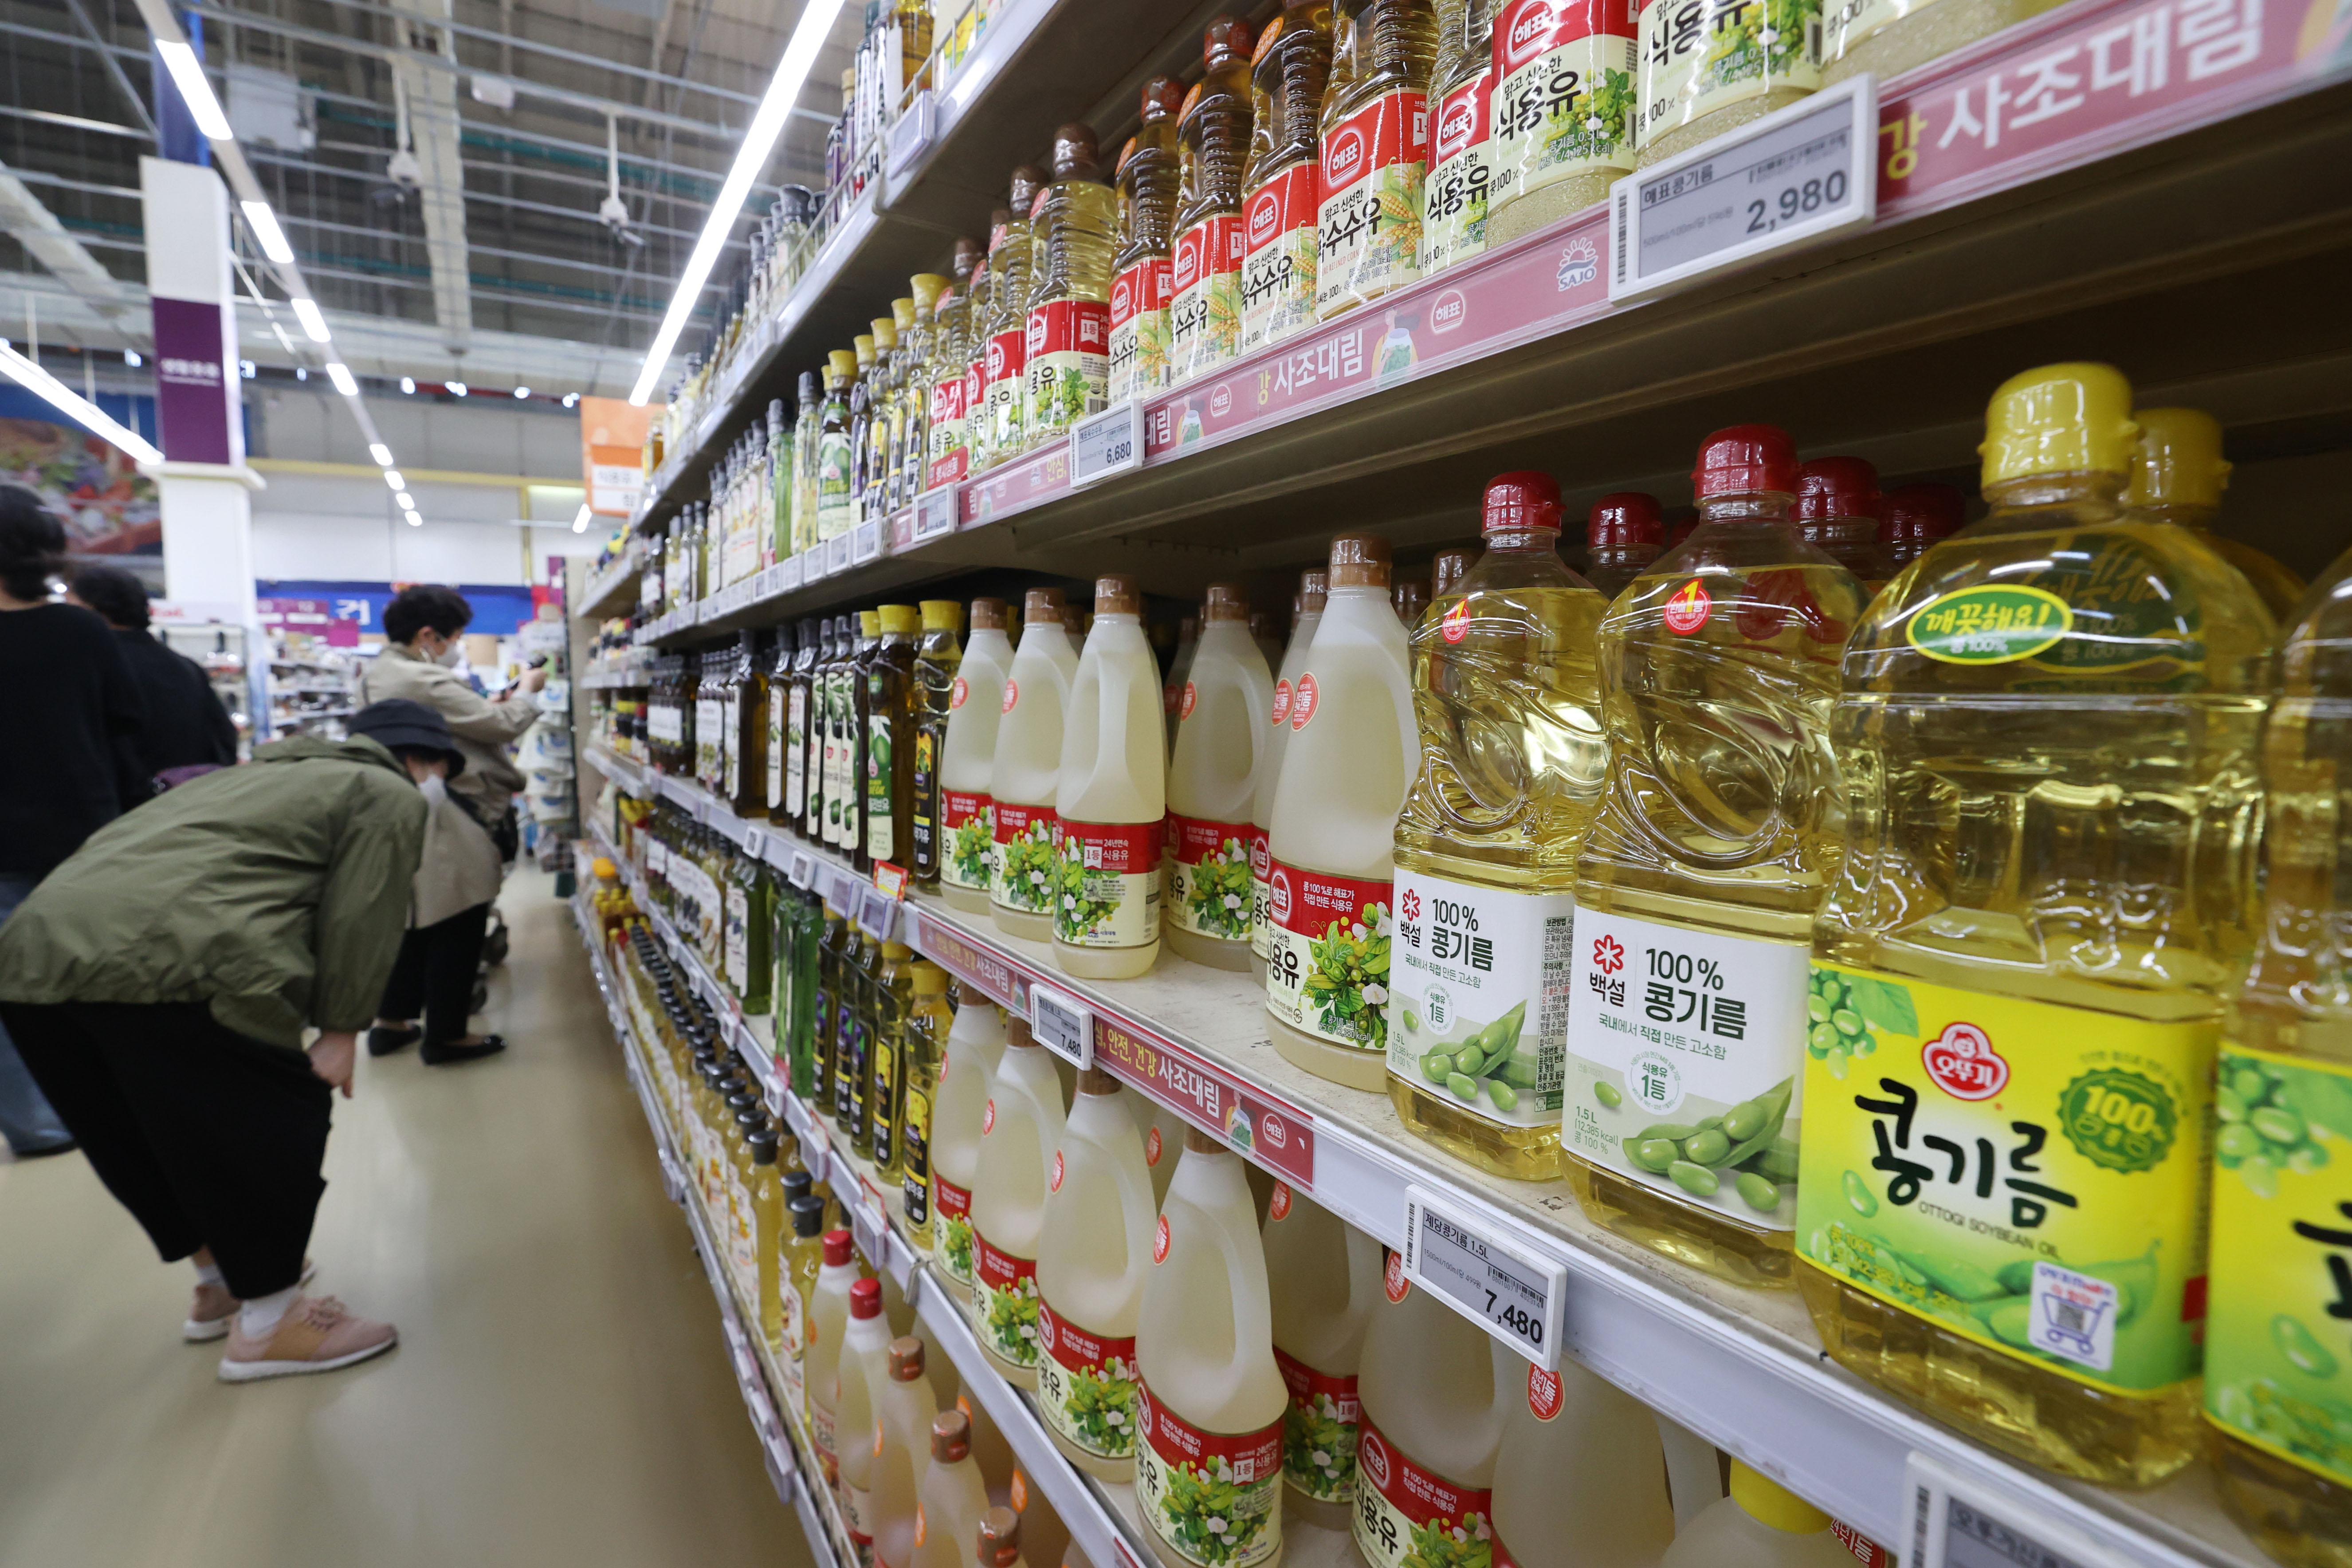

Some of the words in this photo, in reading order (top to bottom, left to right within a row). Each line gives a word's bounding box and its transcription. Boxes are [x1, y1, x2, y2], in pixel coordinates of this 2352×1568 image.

[1515, 8, 1549, 43] 해표
[1504, 76, 1523, 101] 맑고
[1526, 55, 1562, 83] 신선한
[1879, 111, 1928, 179] 강
[1937, 0, 2265, 149] 사조대림
[1494, 71, 1581, 141] 식용유
[1443, 113, 1469, 139] 해표
[1549, 135, 1575, 152] 콩기름
[1591, 143, 1614, 155] kcal)
[1332, 141, 1358, 170] 해표
[1435, 165, 1448, 187] 맑고
[1450, 152, 1479, 176] 신선한
[1428, 165, 1488, 223] 식용유
[1746, 169, 1847, 234] 2,980
[1325, 204, 1339, 223] 맑고
[1341, 188, 1364, 210] 신선한
[1254, 206, 1274, 228] 해표
[1177, 254, 1193, 273] 해표
[1248, 260, 1260, 275] 맑고
[1260, 246, 1278, 267] 신선한
[1559, 267, 1596, 291] SAJO
[1114, 295, 1127, 310] 해표
[1183, 292, 1197, 310] 신선한
[1172, 300, 1208, 344] 수수유
[1436, 303, 1461, 321] 해표
[1083, 323, 1096, 334] 1등
[1257, 372, 1271, 405] 강
[1274, 329, 1363, 395] 사조대림
[1213, 392, 1229, 408] 해표
[1107, 441, 1131, 465] 6,680
[1926, 603, 2051, 636] 깨끗해요!
[1968, 637, 2008, 652] 100%
[1087, 850, 1100, 860] 1등
[1103, 850, 1129, 861] 식용유
[1272, 887, 1287, 907] 해표
[1304, 893, 1315, 905] 직접
[1316, 896, 1329, 908] 만든
[1331, 900, 1353, 912] 식용유
[1334, 888, 1355, 900] 해표가
[1545, 926, 1573, 935] 보관하십시오
[1546, 918, 1566, 927] 보관방법
[1276, 930, 1290, 948] 신선한
[1400, 920, 1421, 947] 백설
[1551, 935, 1560, 943] 특유
[1431, 925, 1493, 973] 콩기름
[1544, 952, 1558, 961] 있으니
[1405, 953, 1427, 973] 국내에서
[1429, 959, 1441, 978] 직접
[1442, 965, 1456, 982] 만든
[1458, 971, 1481, 989] 고소함
[1543, 962, 1563, 971] 주의사항
[1430, 992, 1445, 1005] 식용유
[1589, 972, 1625, 1007] 백설
[1328, 1015, 1343, 1027] 콩기름
[1429, 1002, 1444, 1023] 1등
[1541, 1013, 1551, 1022] 해결
[1644, 981, 1747, 1040] 콩기름
[1540, 1021, 1550, 1030] 받을
[1061, 1034, 1081, 1057] 7,480
[1356, 1031, 1371, 1042] kcal)
[1599, 1013, 1637, 1037] 국내에서
[1640, 1024, 1661, 1044] 직접
[1664, 1031, 1687, 1051] 만든
[1690, 1037, 1727, 1061] 고소함
[1392, 1052, 1396, 1062] 콩
[1397, 1056, 1406, 1066] 100
[1539, 1045, 1559, 1056] 인증번호
[1539, 1057, 1553, 1065] 표준의
[1554, 1054, 1564, 1063] 번호
[1107, 1028, 1132, 1065] 안전,
[1134, 1042, 1157, 1078] 건강
[1159, 1056, 1220, 1119] 사조대림
[1537, 1074, 1547, 1082] 종류
[1549, 1073, 1554, 1081] 및
[1555, 1071, 1564, 1080] 등급
[1544, 1063, 1555, 1073] 명칭
[1642, 1062, 1668, 1078] 식용유
[1936, 1056, 1993, 1088] 오뚜기
[1537, 1081, 1561, 1092] 인증기관명
[1641, 1075, 1665, 1100] 1등
[1576, 1106, 1589, 1120] 1.5
[1265, 1121, 1282, 1140] 해표
[1575, 1118, 1599, 1137] (12,385
[1601, 1131, 1618, 1146] kcal)
[1575, 1131, 1581, 1143] 콩
[1585, 1136, 1598, 1149] 100
[1601, 1142, 1608, 1154] %
[1855, 1078, 2077, 1227] 콩기름
[1918, 1200, 1965, 1227] OTTOGI
[1426, 1213, 1467, 1248] 제당콩기름
[1471, 1241, 1489, 1259] 1.5L
[1465, 1274, 1481, 1290] 499원
[1485, 1288, 1543, 1344] 7,480
[1237, 1463, 1252, 1476] 1등
[1403, 1477, 1416, 1493] 직접
[1417, 1486, 1431, 1502] 만든
[1433, 1495, 1455, 1514] 식용유
[1410, 1471, 1421, 1485] 100
[1436, 1486, 1457, 1504] 해표가
[1355, 1479, 1398, 1556] 식용유
